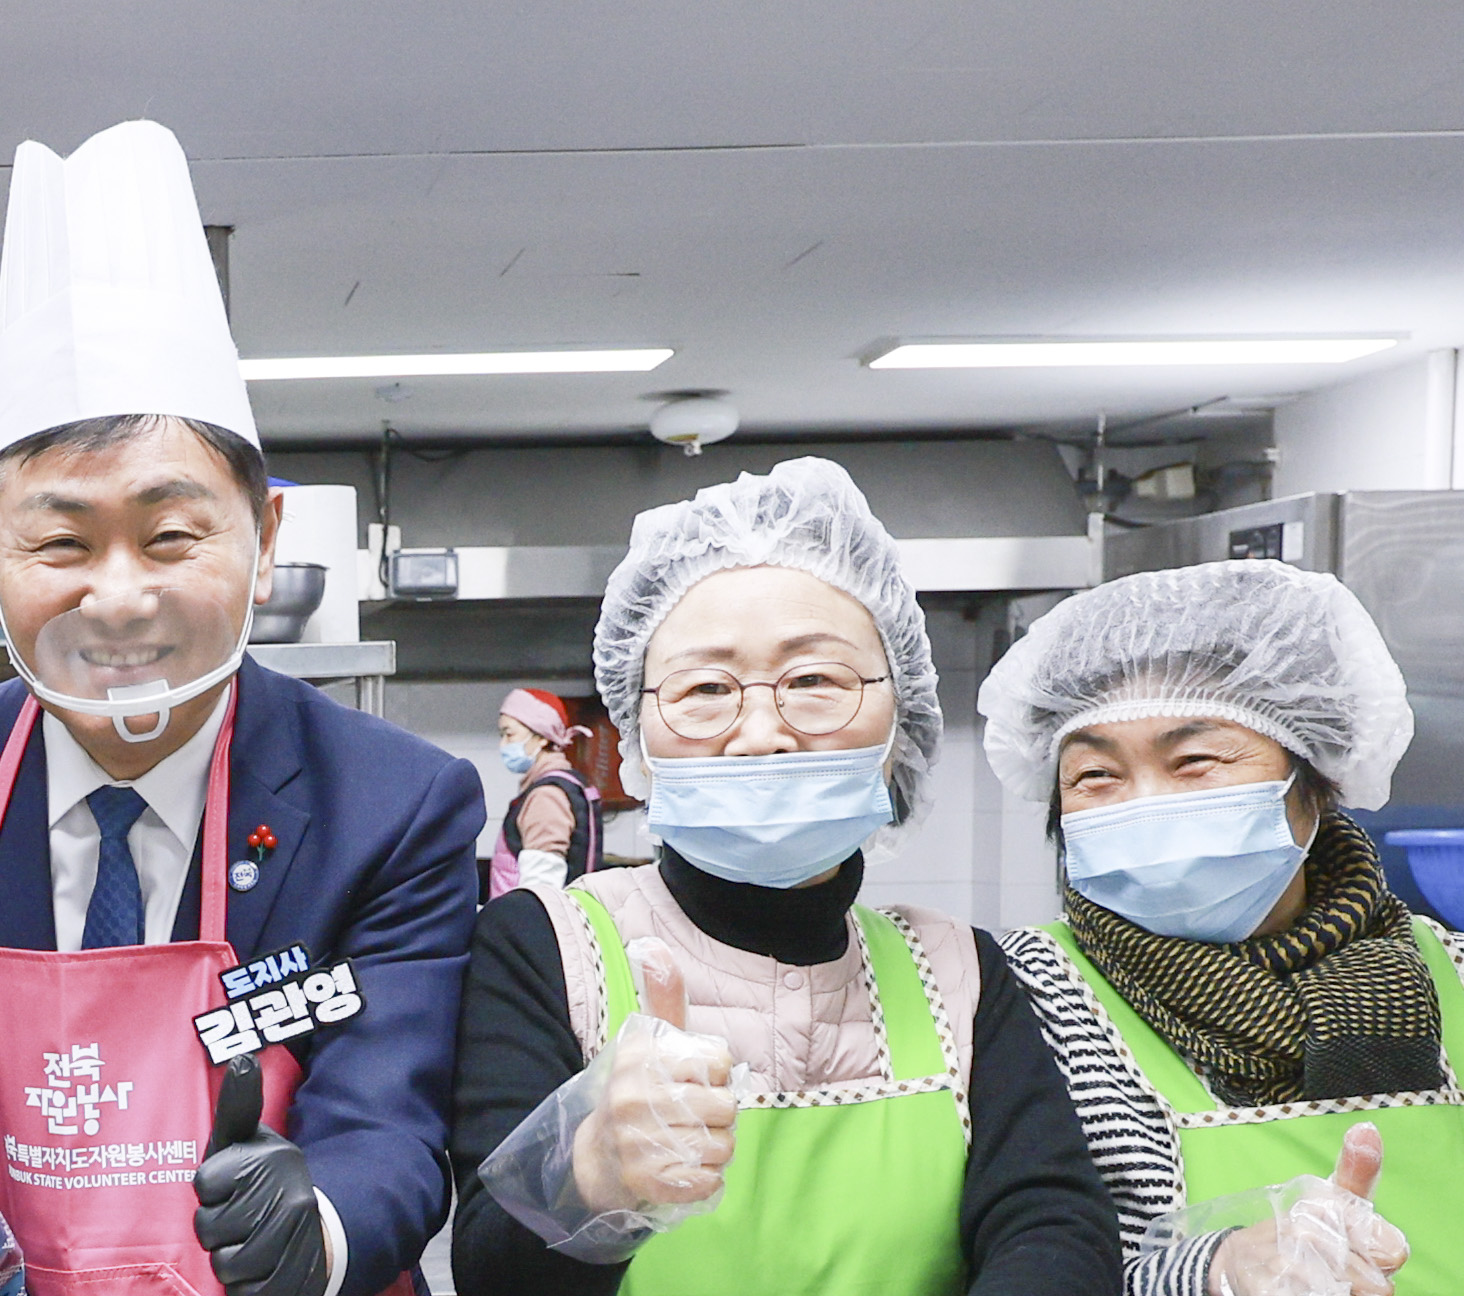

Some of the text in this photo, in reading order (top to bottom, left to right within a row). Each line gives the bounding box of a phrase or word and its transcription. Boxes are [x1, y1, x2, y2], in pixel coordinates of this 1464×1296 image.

[221, 946, 310, 999] 도지사
[194, 962, 362, 1065] 김관영
[43, 1043, 106, 1088] 전북
[24, 1081, 134, 1136] 자원봉사
[34, 1173, 63, 1190] STATE
[65, 1169, 147, 1190] VOLUNTEER
[148, 1169, 197, 1184] CENTER
